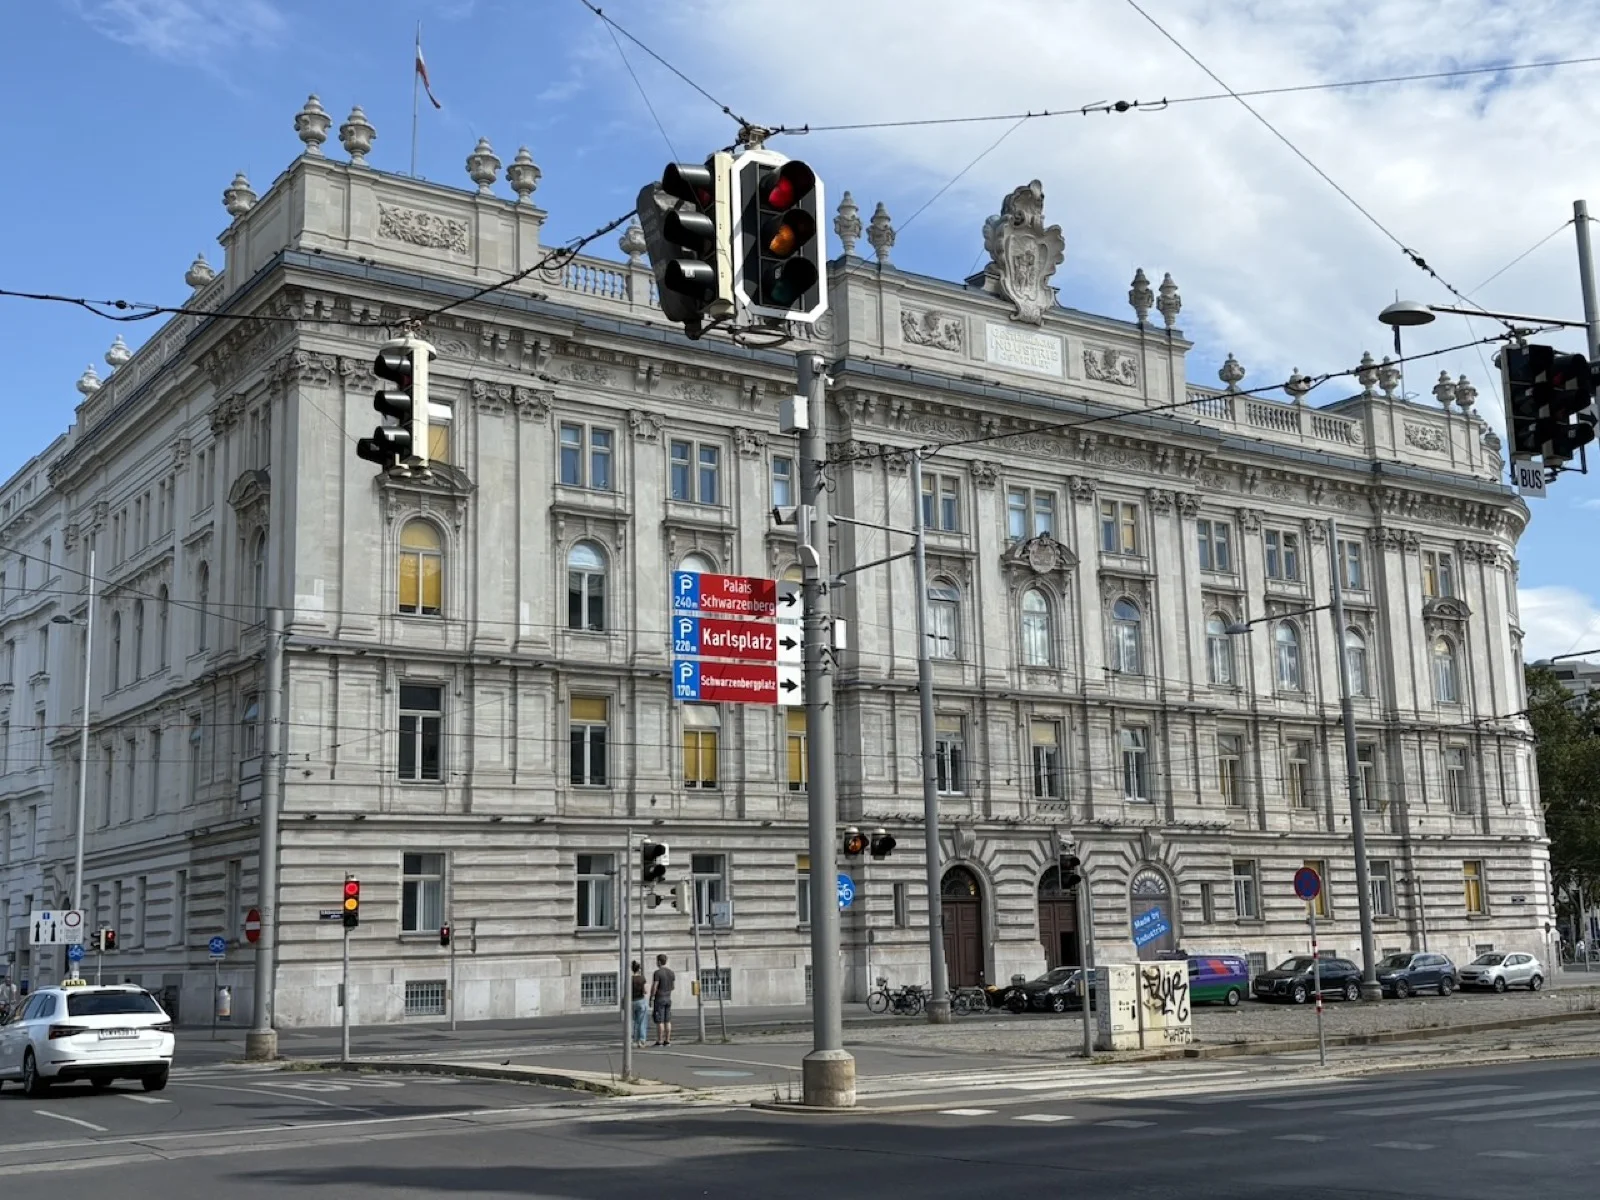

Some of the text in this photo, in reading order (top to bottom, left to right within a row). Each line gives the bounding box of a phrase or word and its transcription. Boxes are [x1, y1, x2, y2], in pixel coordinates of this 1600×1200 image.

[1520, 468, 1542, 489] BUS
[723, 579, 752, 594] Palais
[701, 593, 775, 615] Schwarzenberg
[703, 627, 773, 652] Karlsplatz
[701, 675, 776, 691] Schwarzenbergplatz
[249, 1074, 461, 1092] BUS
